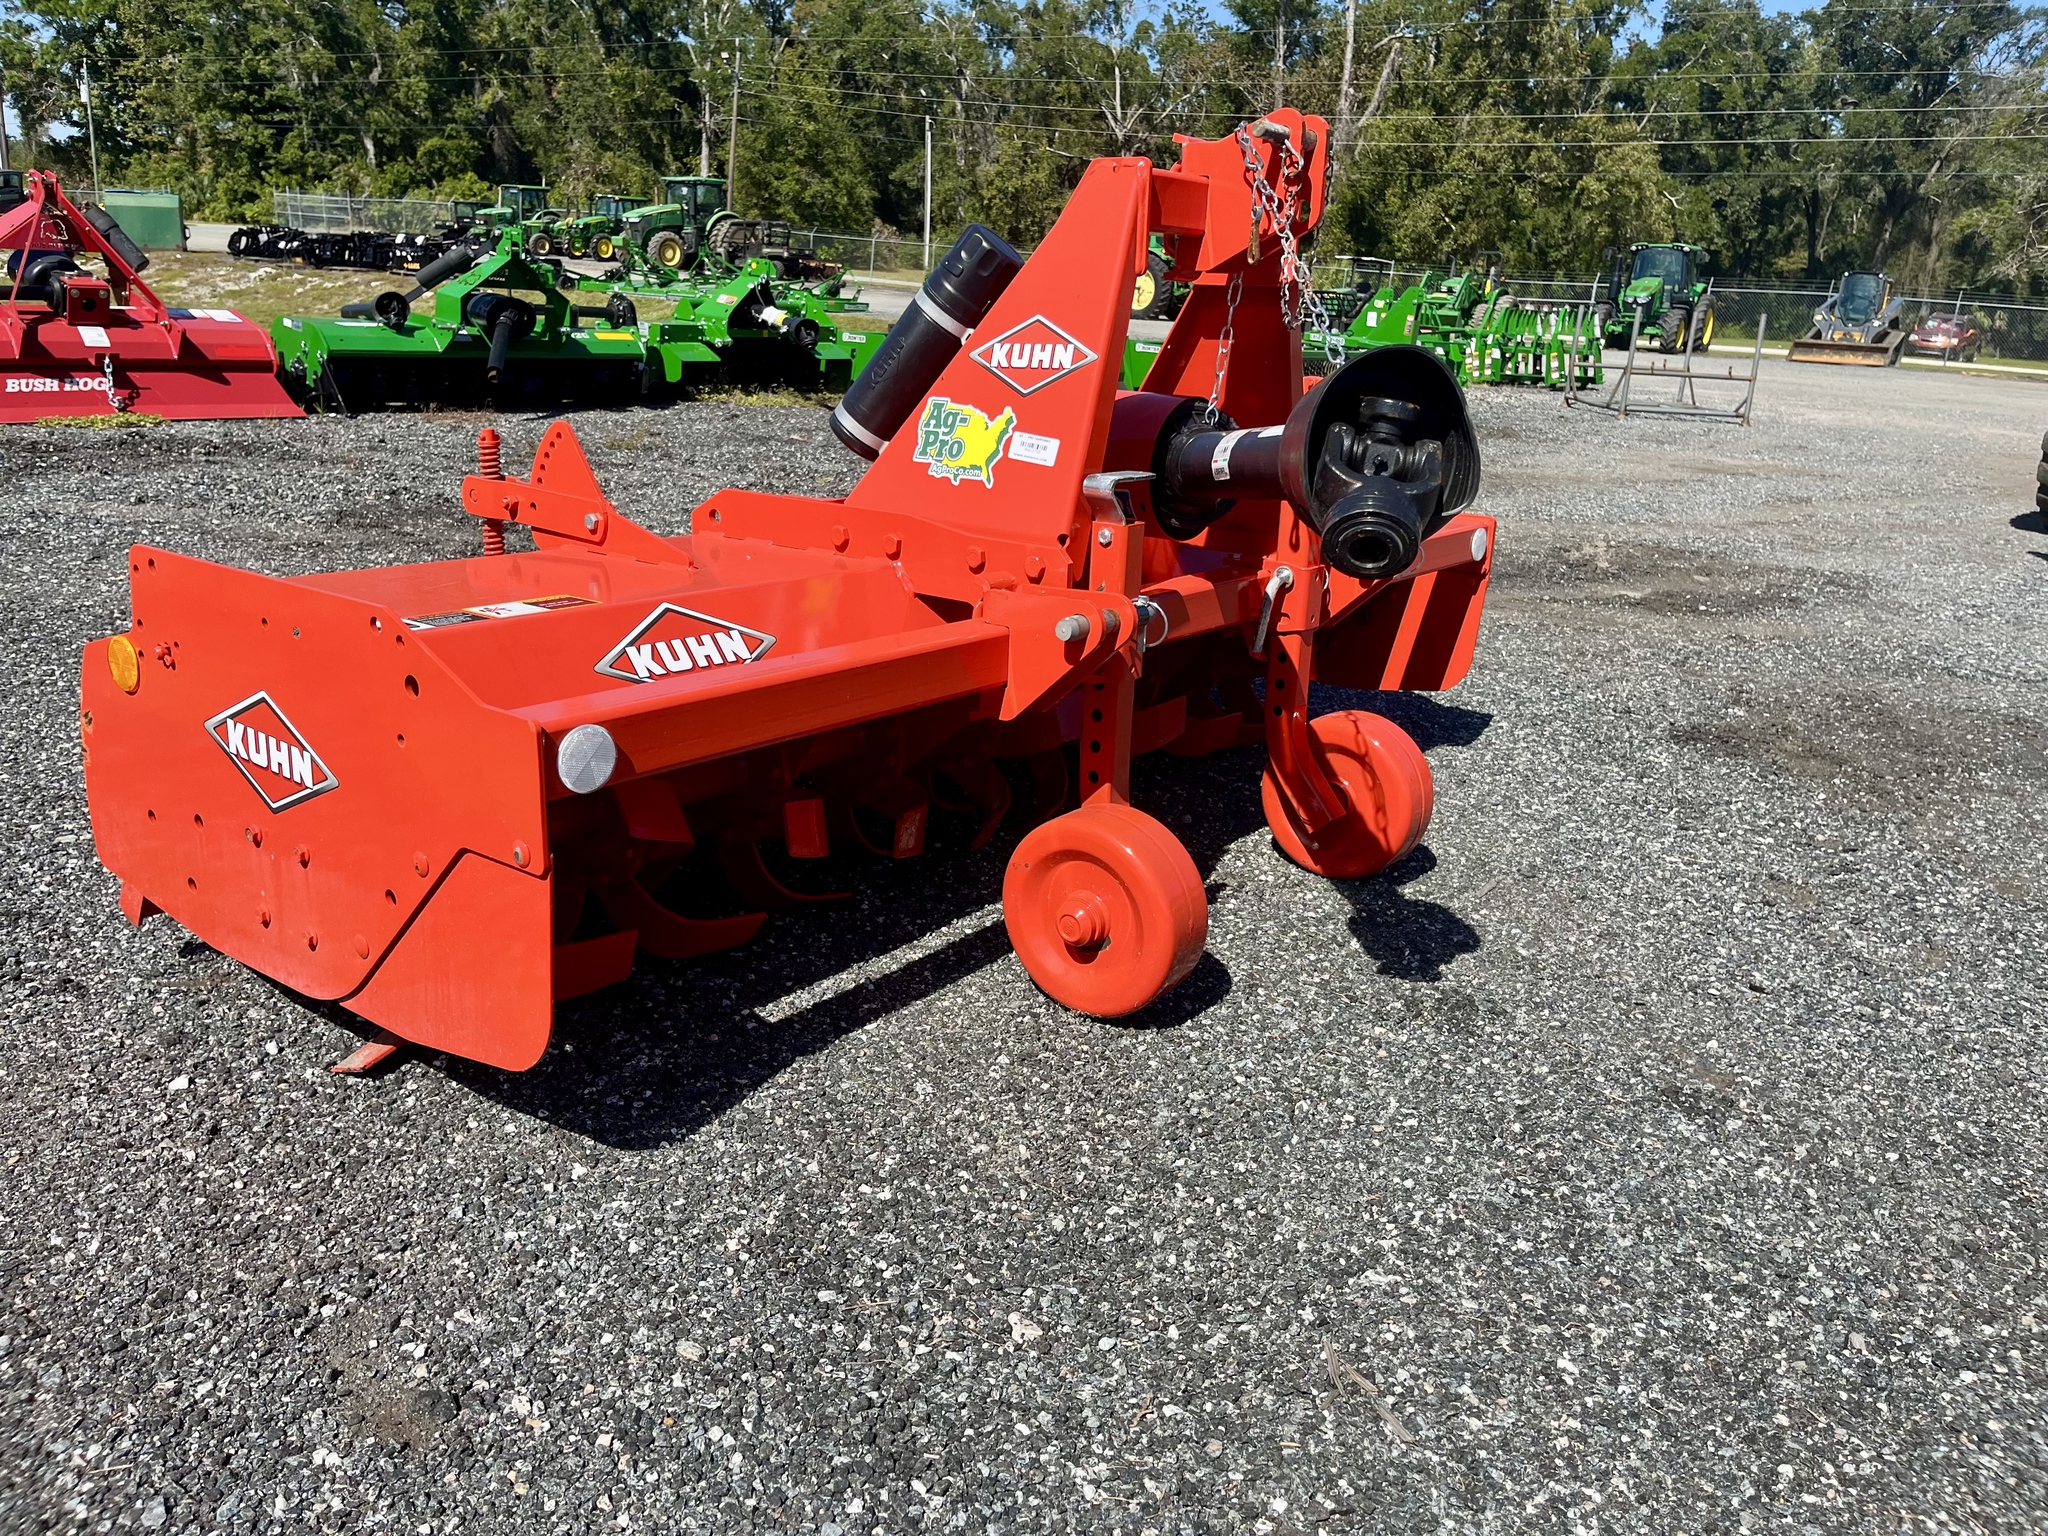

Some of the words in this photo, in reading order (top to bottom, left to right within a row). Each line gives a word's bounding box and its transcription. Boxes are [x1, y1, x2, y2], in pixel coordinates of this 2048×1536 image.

[870, 336, 906, 390] KUHN
[990, 342, 1075, 369] KUHN
[5, 378, 60, 393] BUSH
[63, 377, 108, 392] HOG
[922, 401, 970, 437] Ag-
[918, 430, 964, 460] Pro
[931, 463, 982, 478] AgProCo.com
[624, 629, 752, 679] KUHN
[226, 717, 314, 790] KUHN
